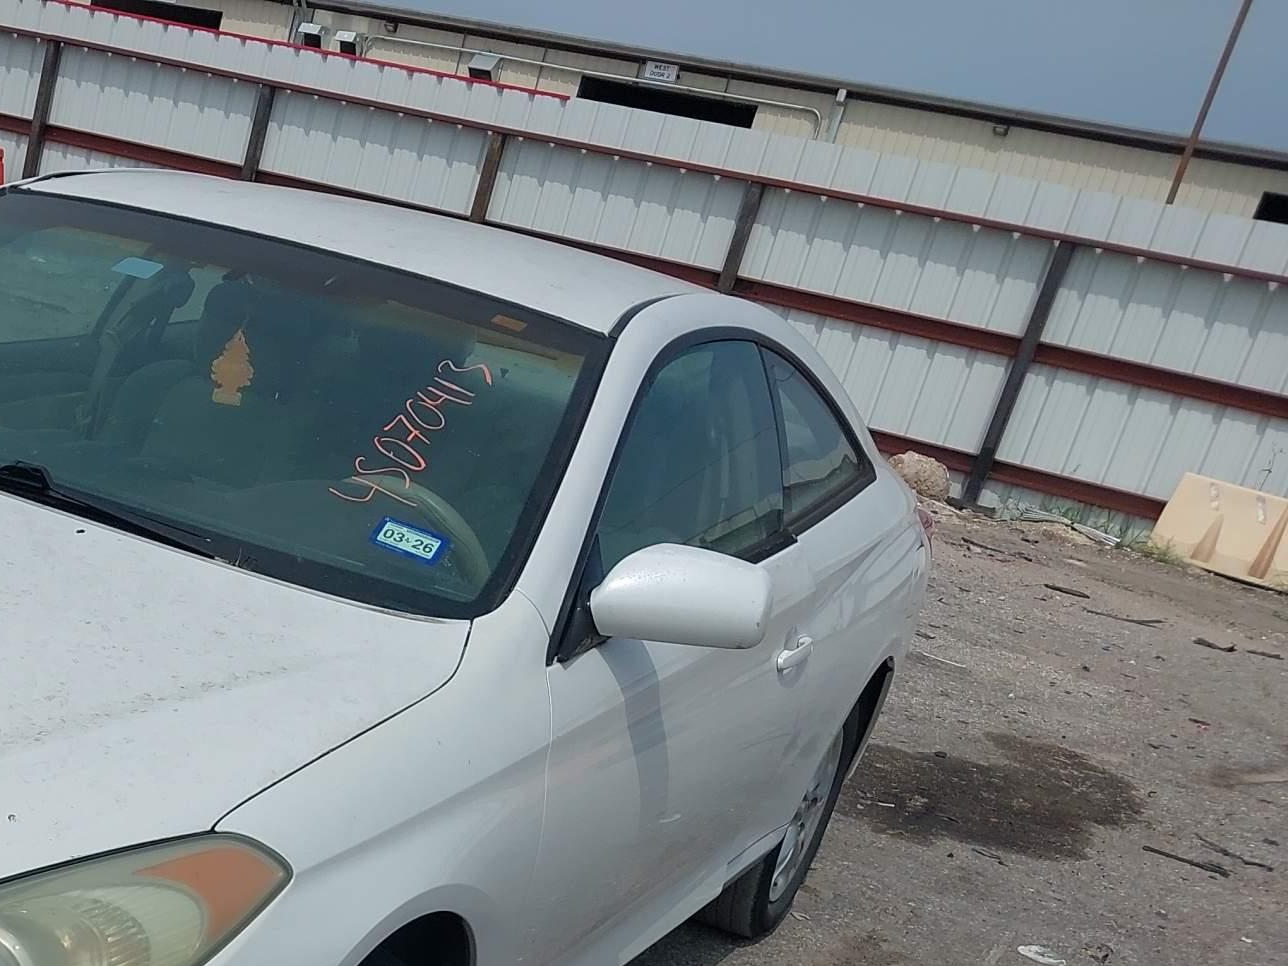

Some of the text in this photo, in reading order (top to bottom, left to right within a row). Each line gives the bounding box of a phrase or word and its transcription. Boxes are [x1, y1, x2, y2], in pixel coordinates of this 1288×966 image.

[328, 359, 493, 507] 45070413
[383, 528, 406, 543] 03
[411, 539, 435, 554] 26
